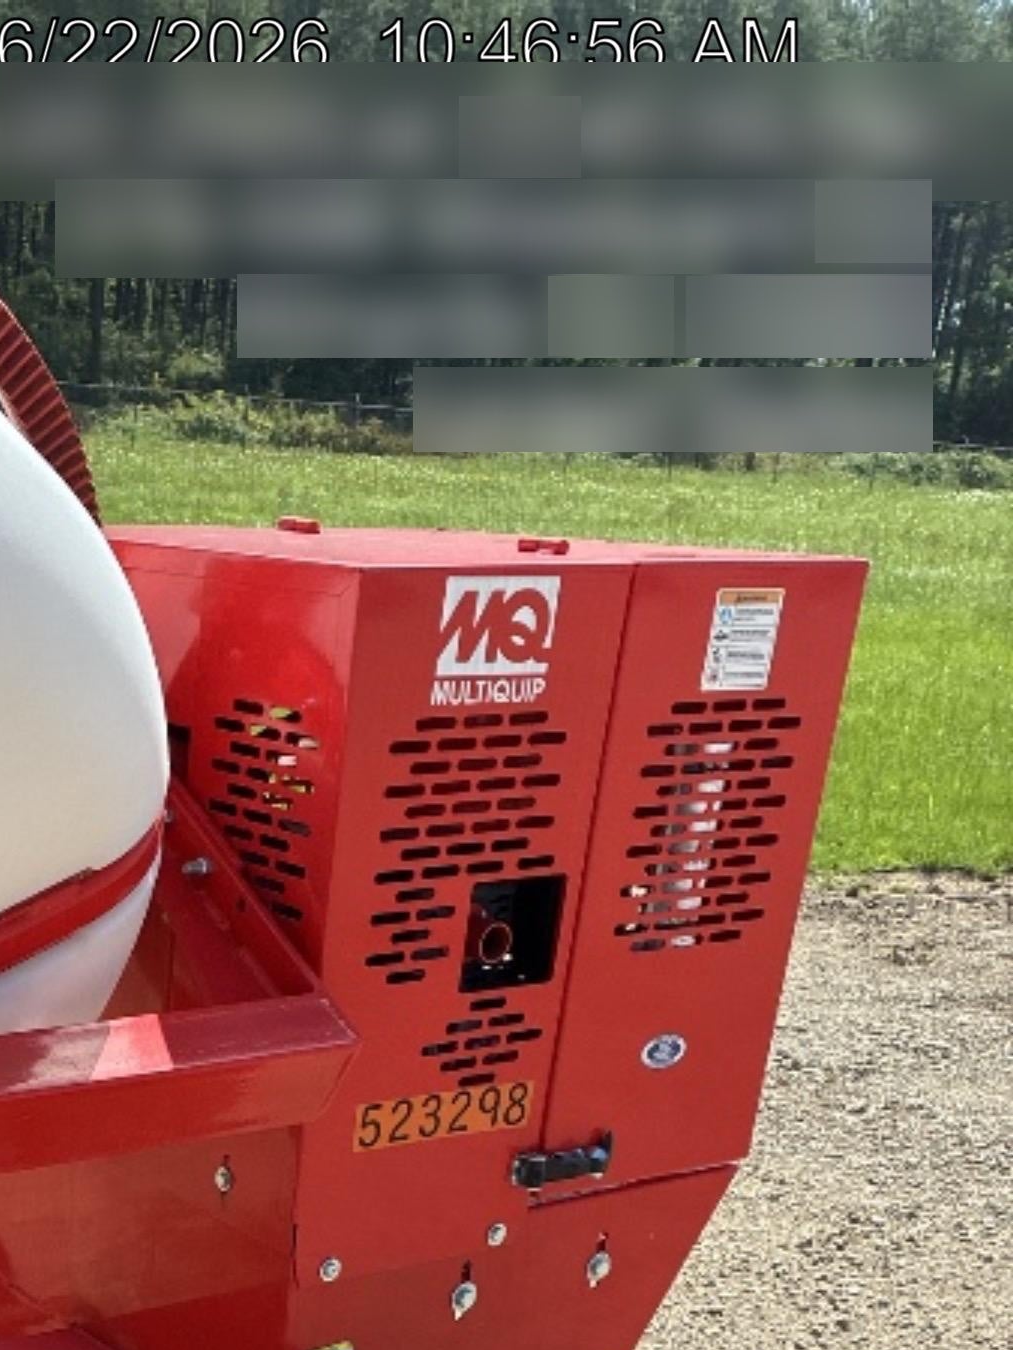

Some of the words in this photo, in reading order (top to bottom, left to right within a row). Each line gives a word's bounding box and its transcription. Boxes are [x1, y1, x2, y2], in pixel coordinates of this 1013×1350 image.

[437, 586, 551, 665] MQ
[430, 677, 546, 706] MULTIQUIP
[358, 1082, 529, 1148] 523298
